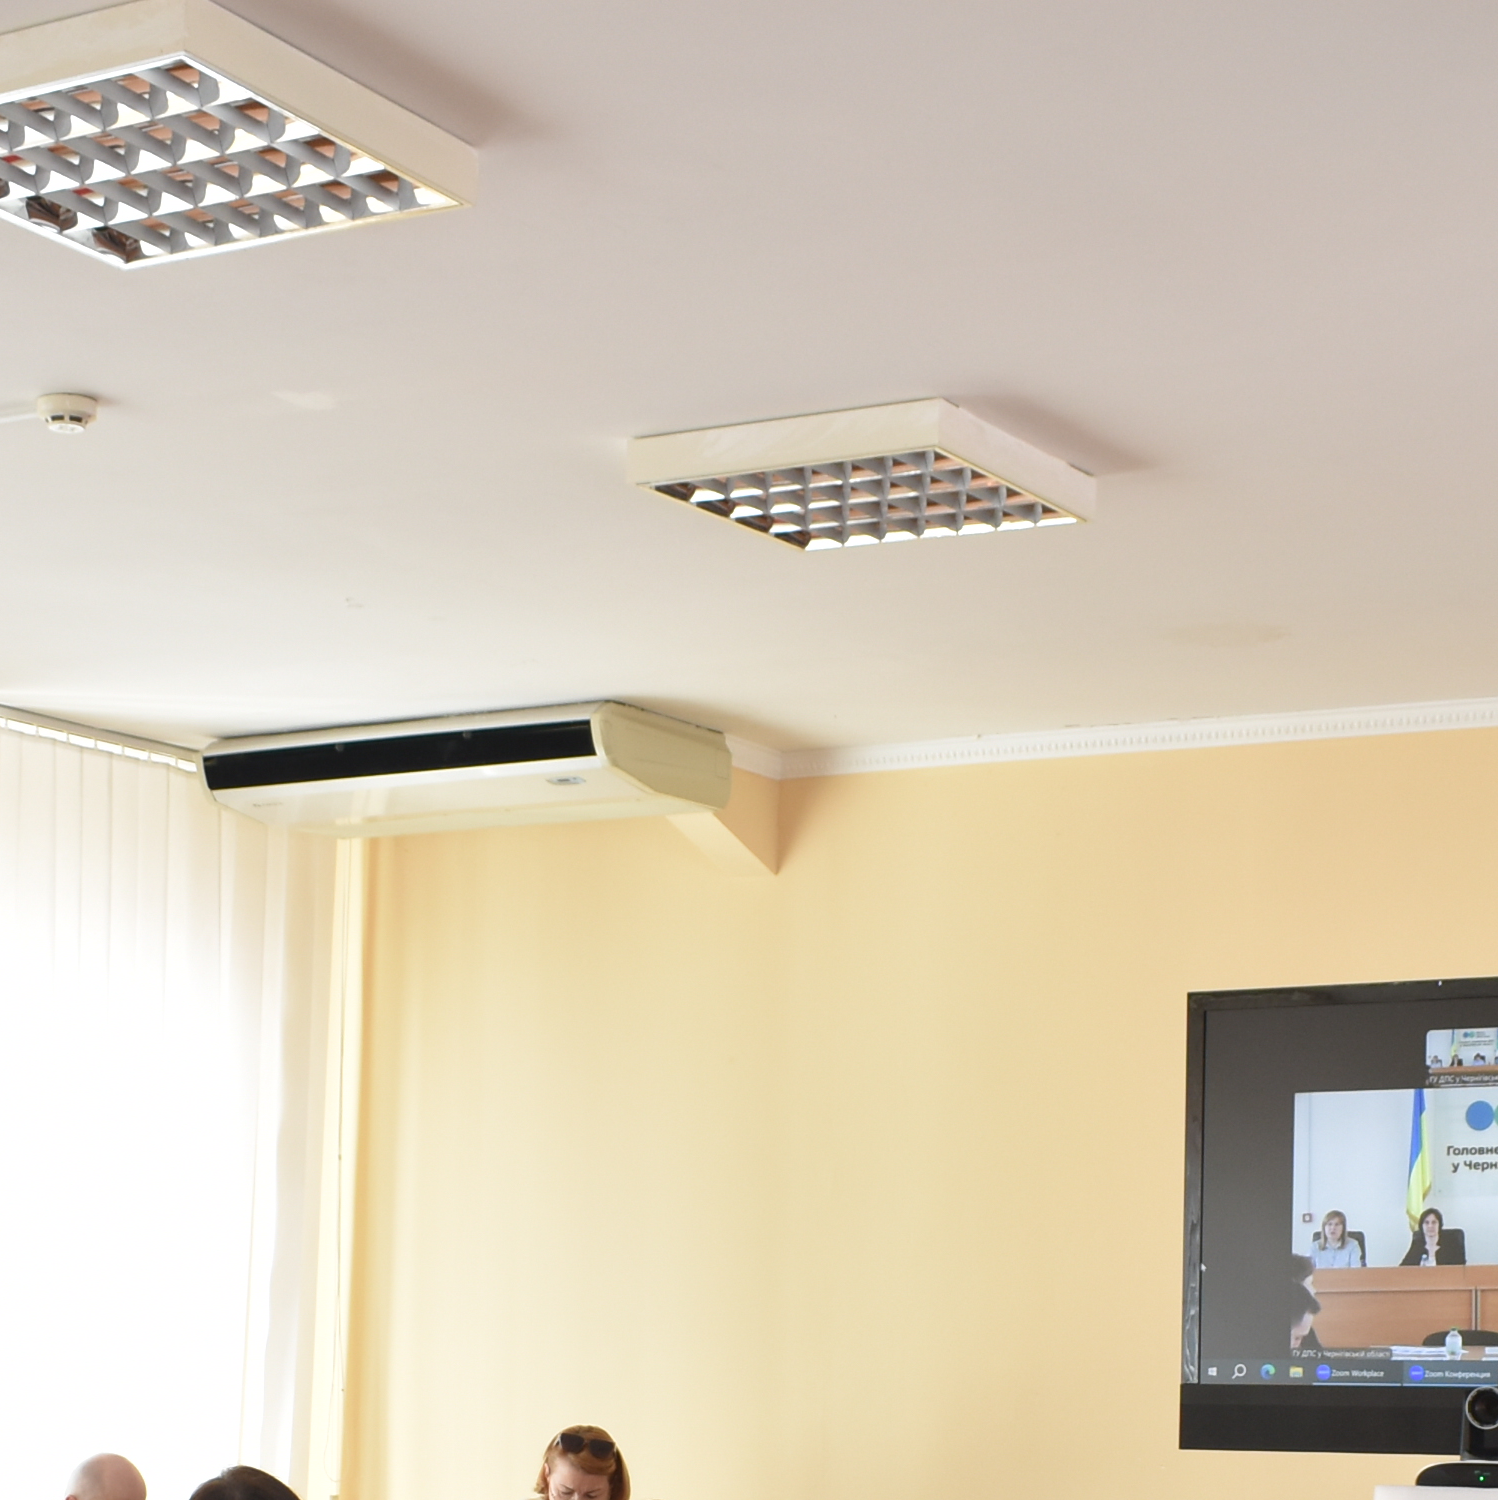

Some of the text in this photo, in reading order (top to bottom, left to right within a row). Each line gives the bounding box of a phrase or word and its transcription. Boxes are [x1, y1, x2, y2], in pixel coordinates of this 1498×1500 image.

[1451, 1161, 1460, 1173] у
[1331, 1369, 1350, 1377] Zoom
[1424, 1370, 1444, 1378] Zoom
